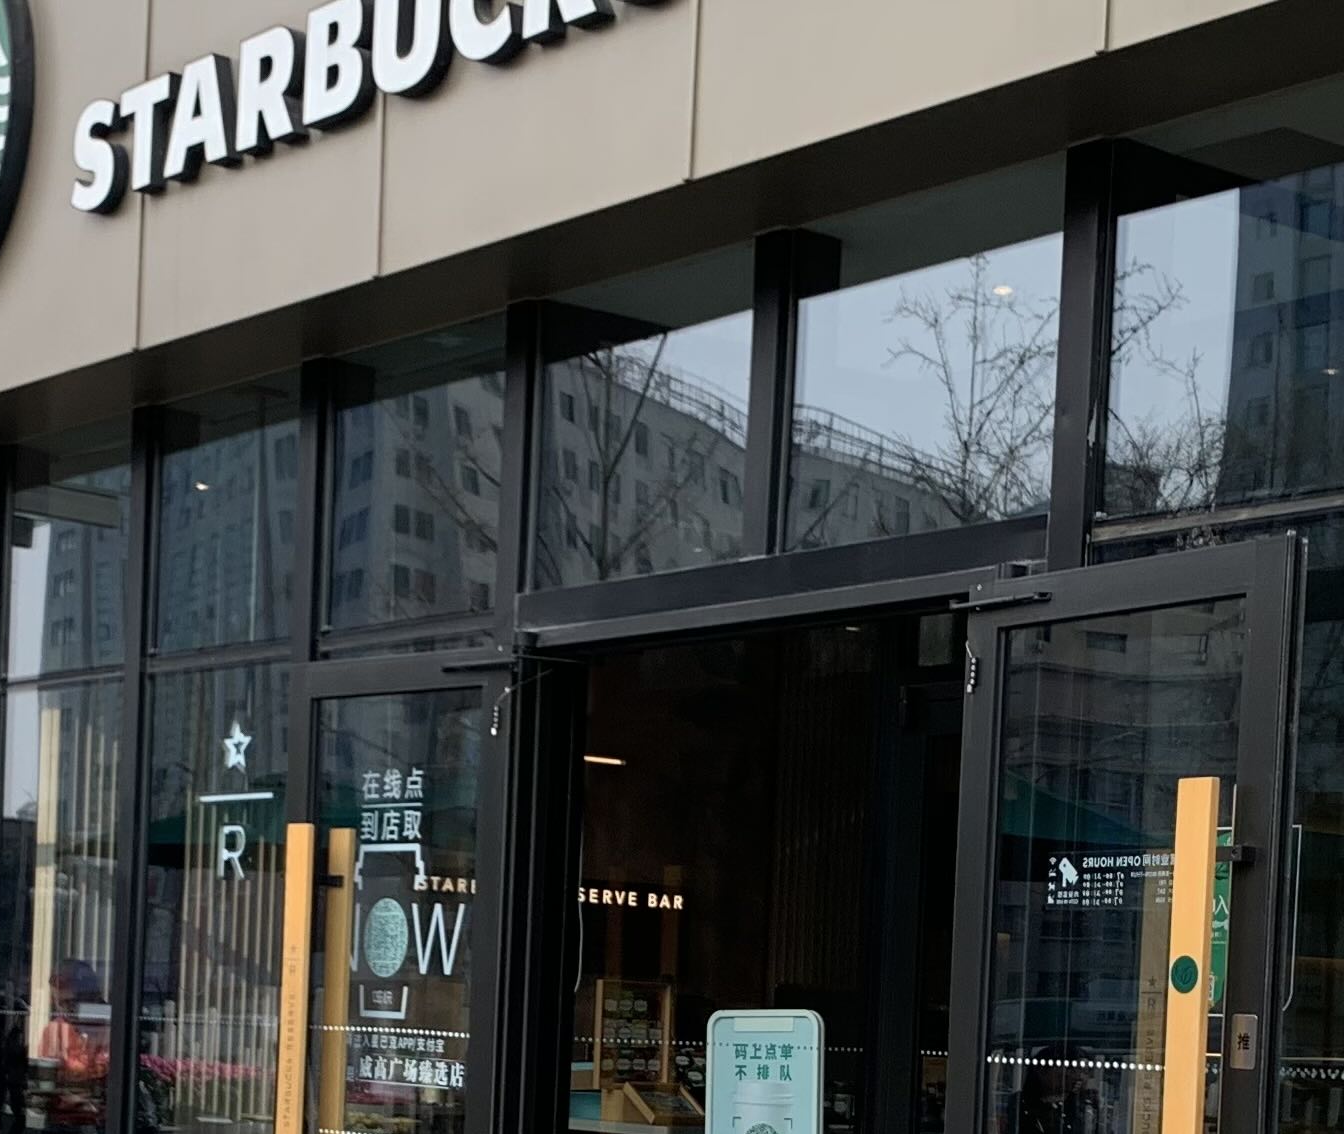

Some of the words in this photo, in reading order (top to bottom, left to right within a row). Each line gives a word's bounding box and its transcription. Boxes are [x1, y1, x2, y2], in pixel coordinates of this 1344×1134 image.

[362, 767, 424, 800] 在线点
[360, 809, 422, 841] 到店取
[217, 824, 245, 880] R
[647, 892, 684, 910] BAR
[733, 1043, 794, 1061] 码上点单
[735, 1064, 793, 1081] 不排队
